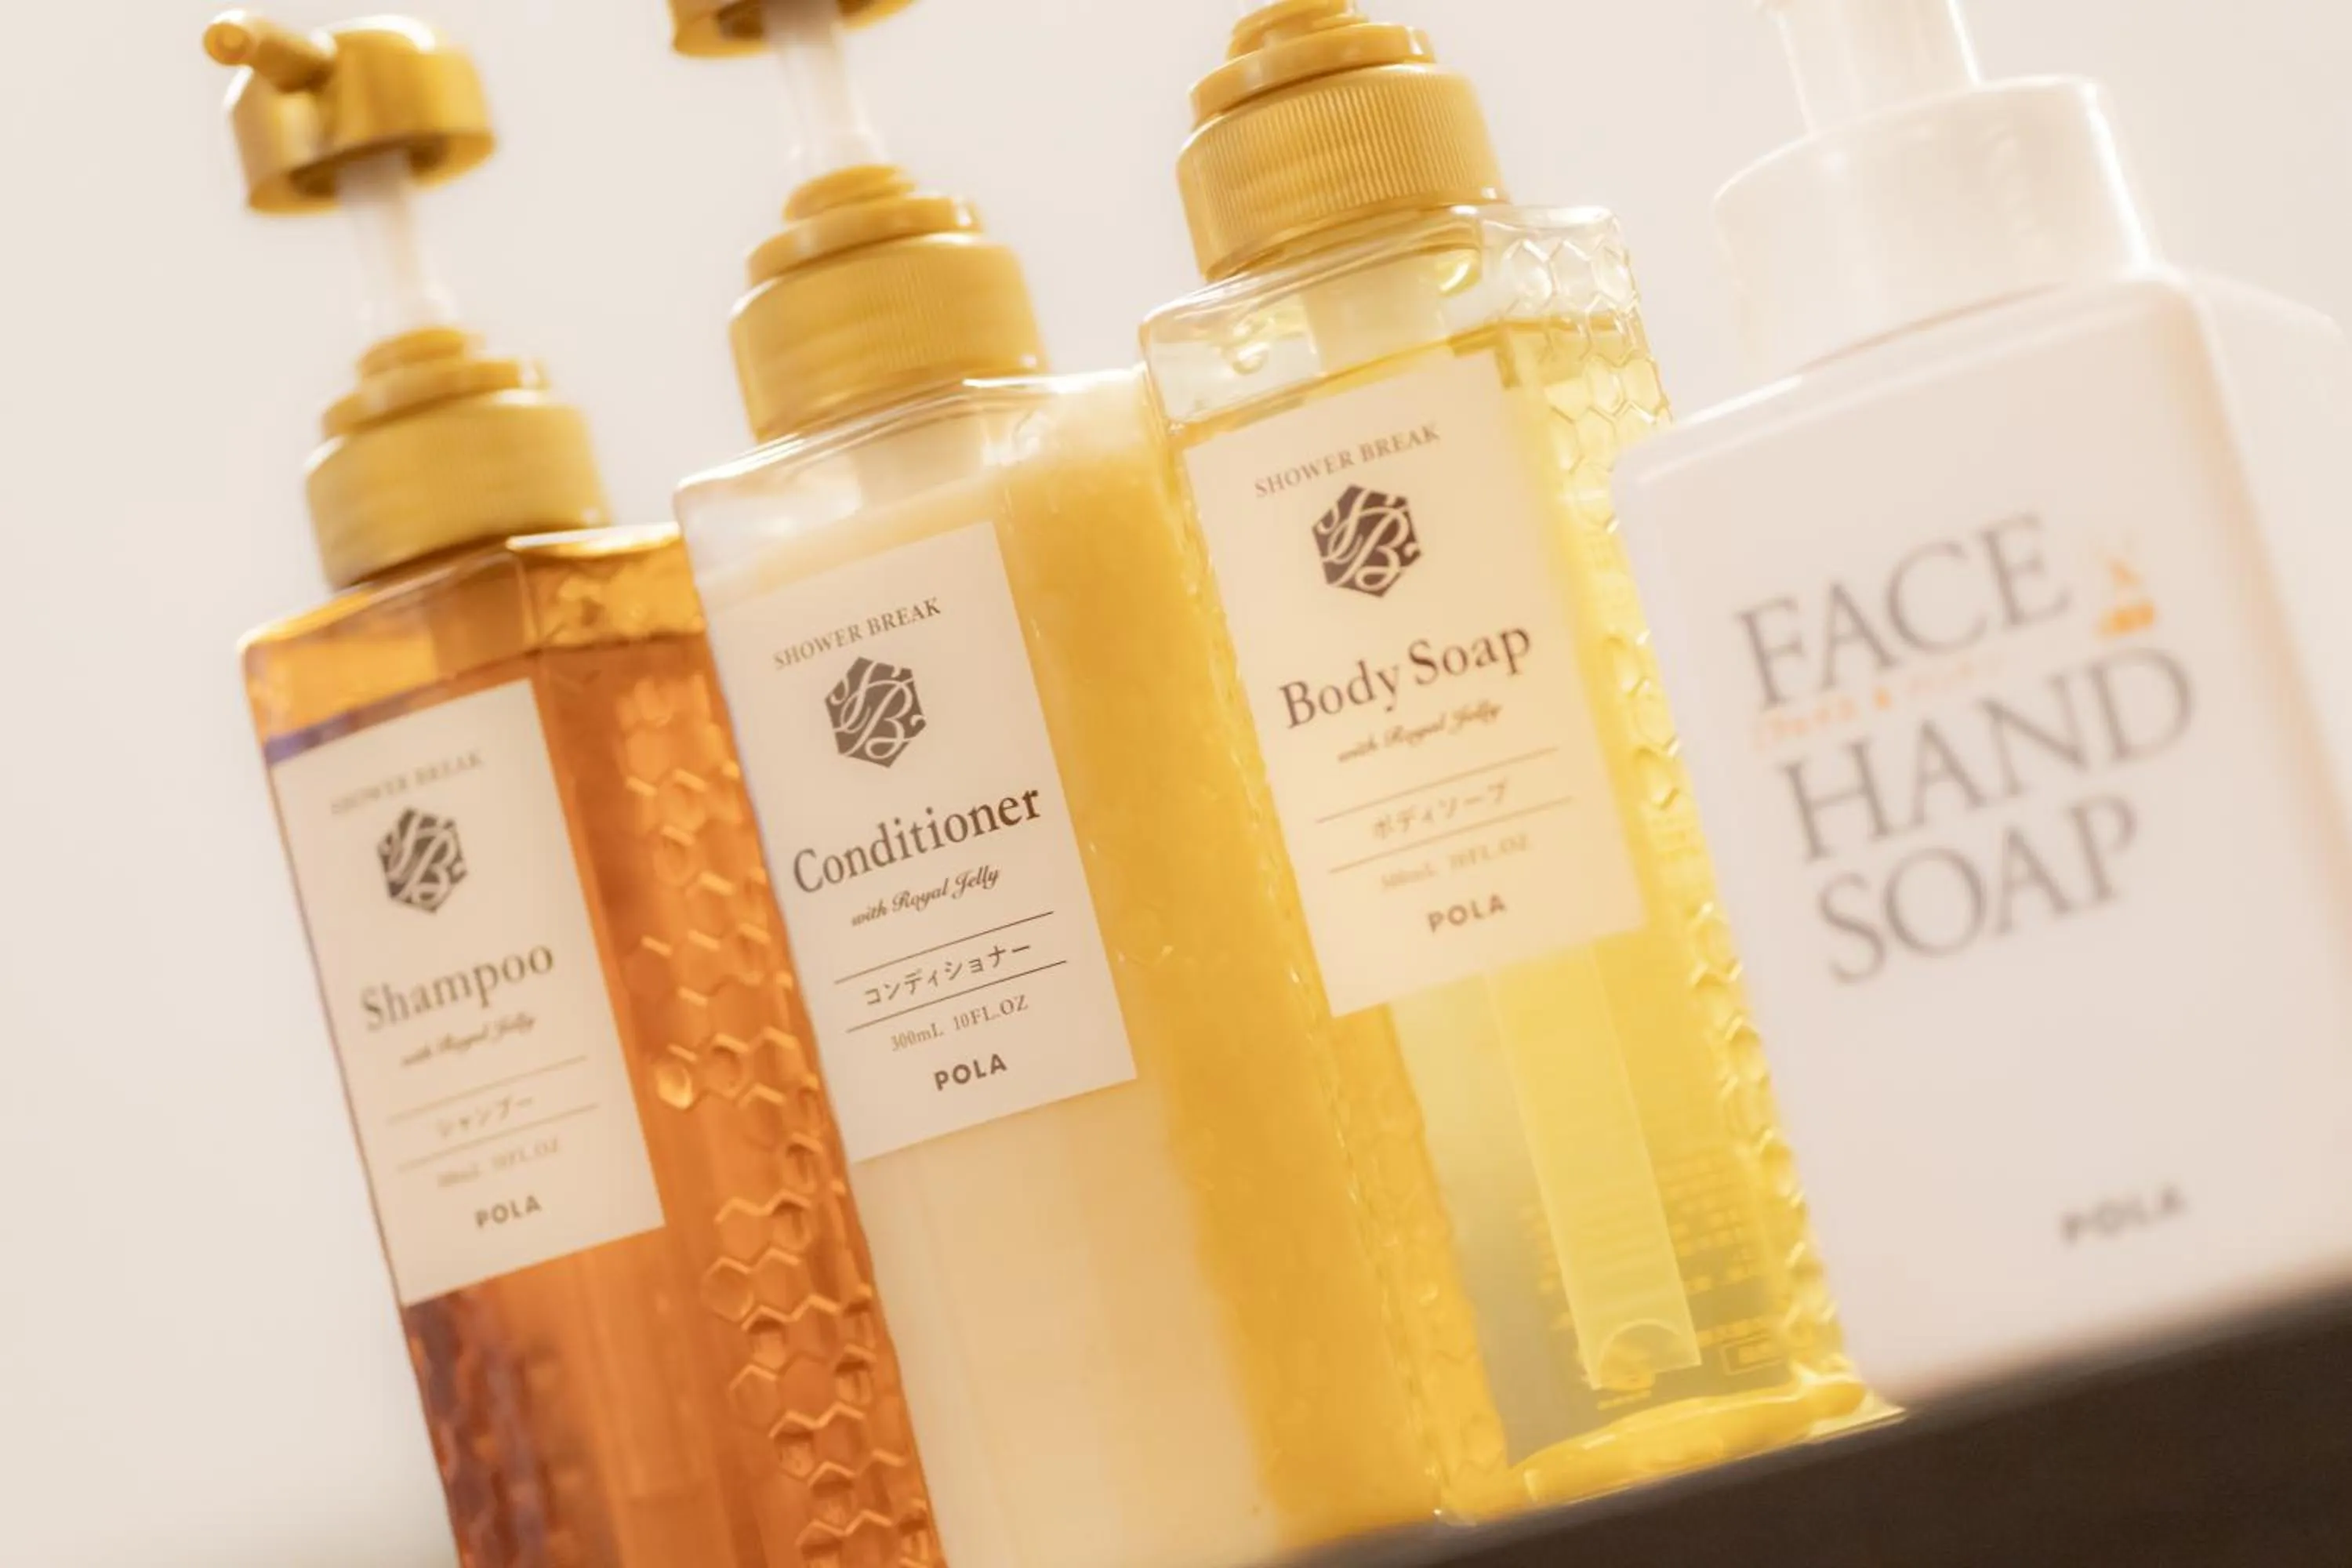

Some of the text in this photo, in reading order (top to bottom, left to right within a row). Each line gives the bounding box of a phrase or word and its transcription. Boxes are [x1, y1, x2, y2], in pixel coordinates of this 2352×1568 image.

[1254, 423, 1440, 497] SHOWER BREAK
[774, 596, 942, 670] SHOWER BREAK
[1734, 512, 2071, 709] FACE
[1279, 627, 1531, 729] Body Soap
[1778, 645, 2196, 863] HAND
[793, 788, 1041, 894] Conditioner
[851, 865, 1000, 927] with Royal Jelly
[1428, 893, 1507, 934] POLA
[1814, 793, 2140, 985] SOAP
[360, 945, 554, 1032] Shampoo
[864, 944, 1030, 1005] コンディショナー
[891, 1022, 944, 1051] 300mL
[934, 1053, 1007, 1091] POLA
[474, 1194, 543, 1229] POLA
[2059, 1185, 2188, 1247] POLA
